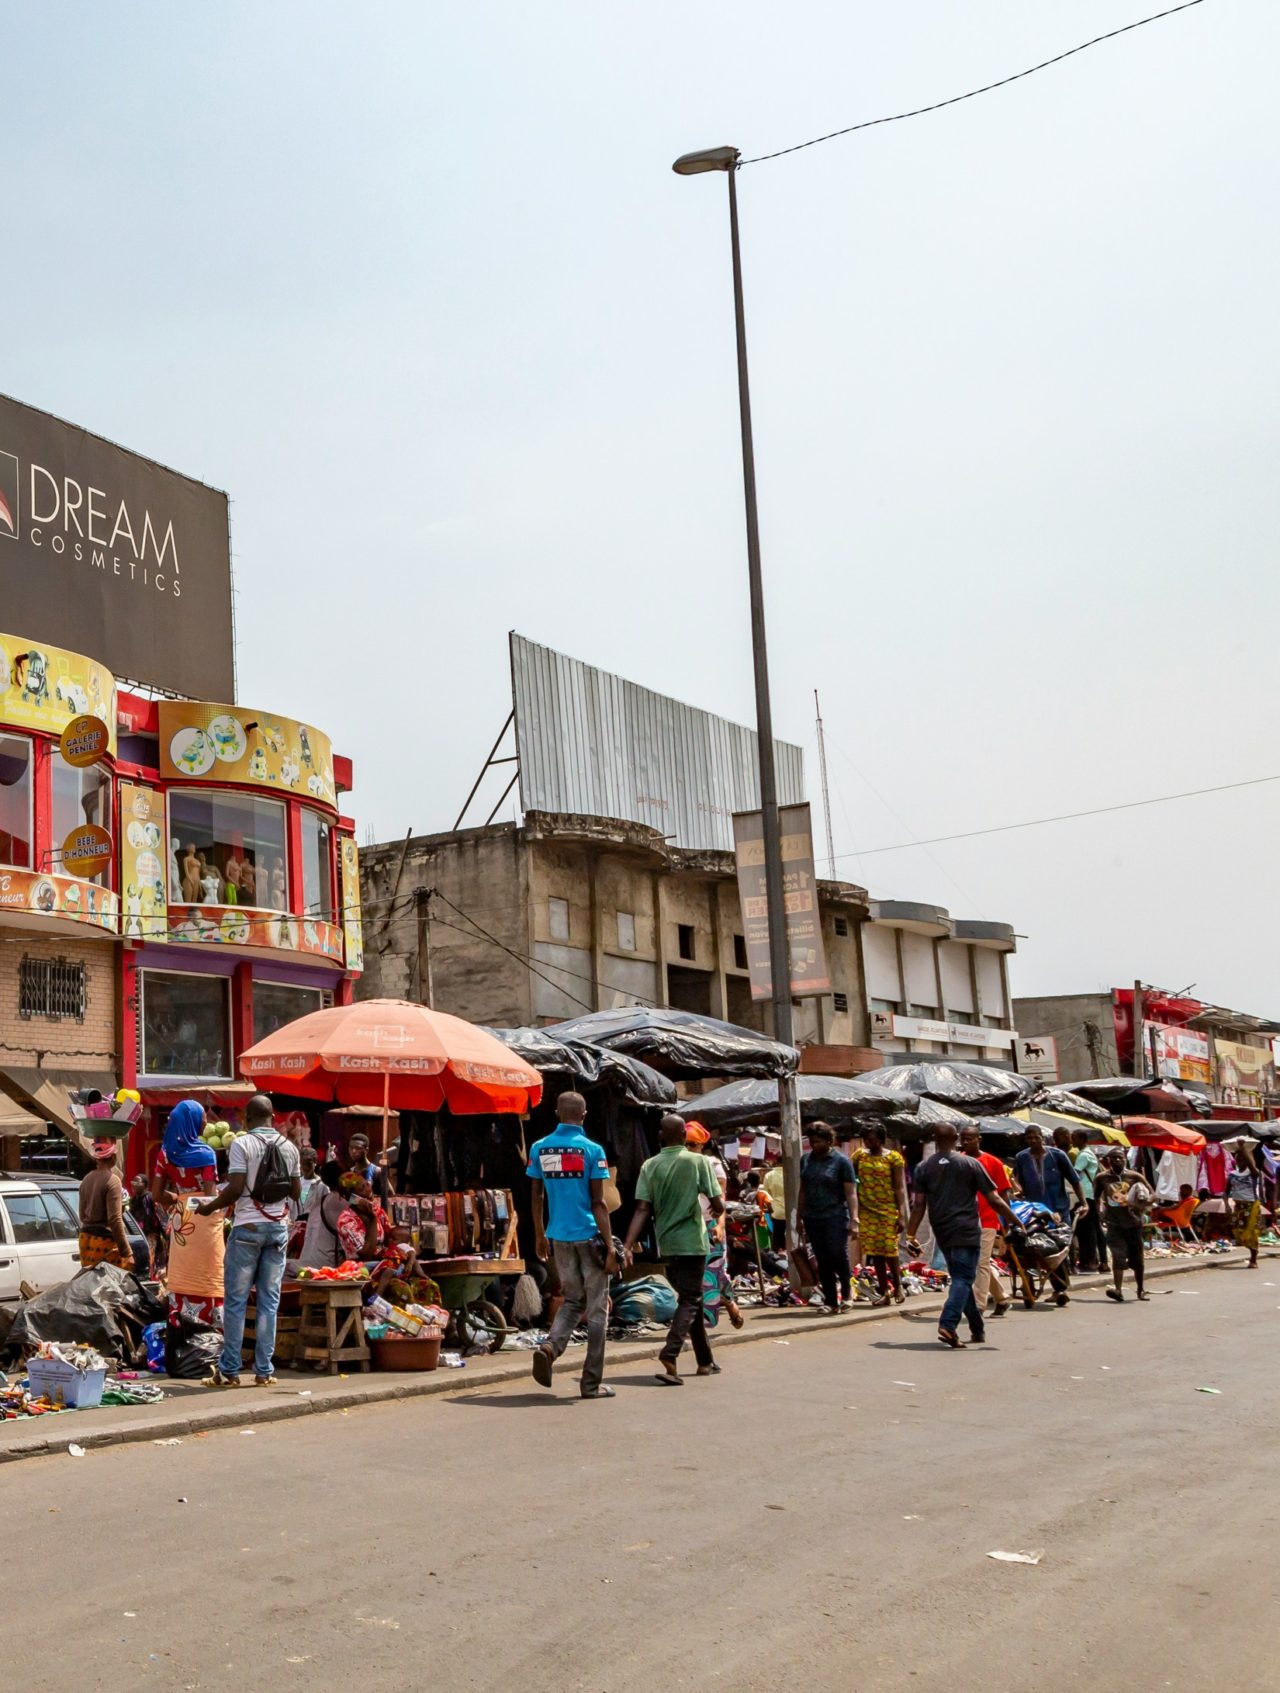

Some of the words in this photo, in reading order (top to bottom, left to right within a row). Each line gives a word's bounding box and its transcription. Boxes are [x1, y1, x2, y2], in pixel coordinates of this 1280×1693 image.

[31, 463, 180, 575] DREAM
[31, 528, 181, 597] COSMETICS
[66, 731, 102, 747] GALERIE
[69, 742, 98, 755] PENIEL
[251, 1057, 276, 1070] Kash
[280, 1056, 306, 1069] Kash
[340, 1055, 380, 1068] Kash
[389, 1056, 429, 1070] Kash
